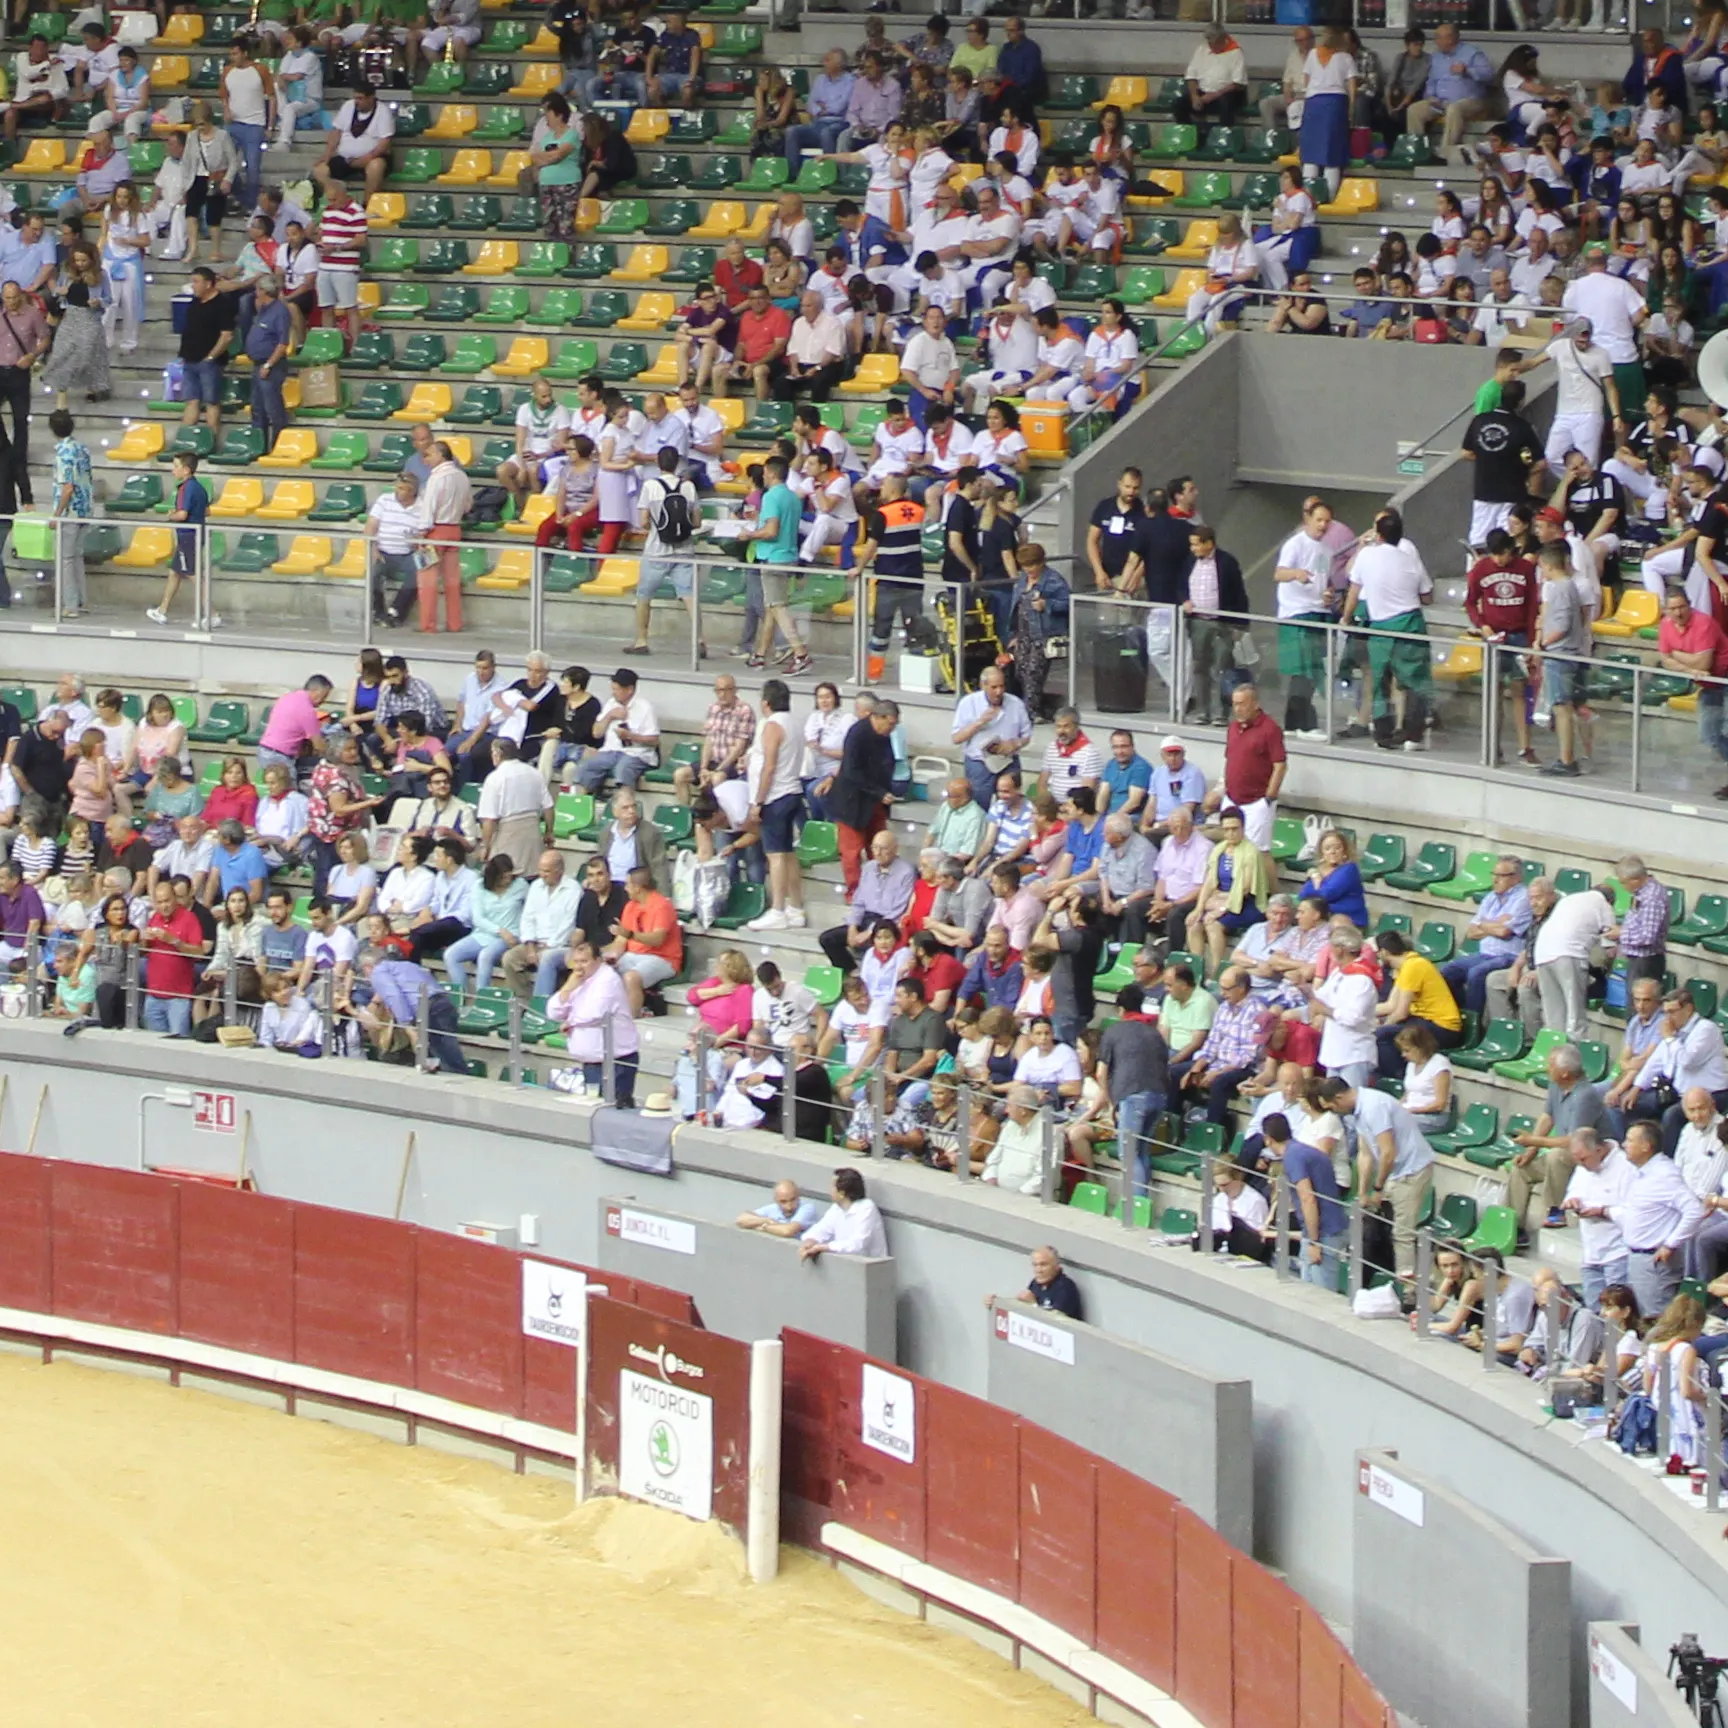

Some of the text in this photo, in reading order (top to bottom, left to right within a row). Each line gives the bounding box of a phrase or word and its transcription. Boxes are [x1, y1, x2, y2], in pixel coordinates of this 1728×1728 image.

[607, 1212, 621, 1230] 05
[630, 1379, 701, 1421] MOTORCID
[643, 1480, 684, 1507] ŠKODA
